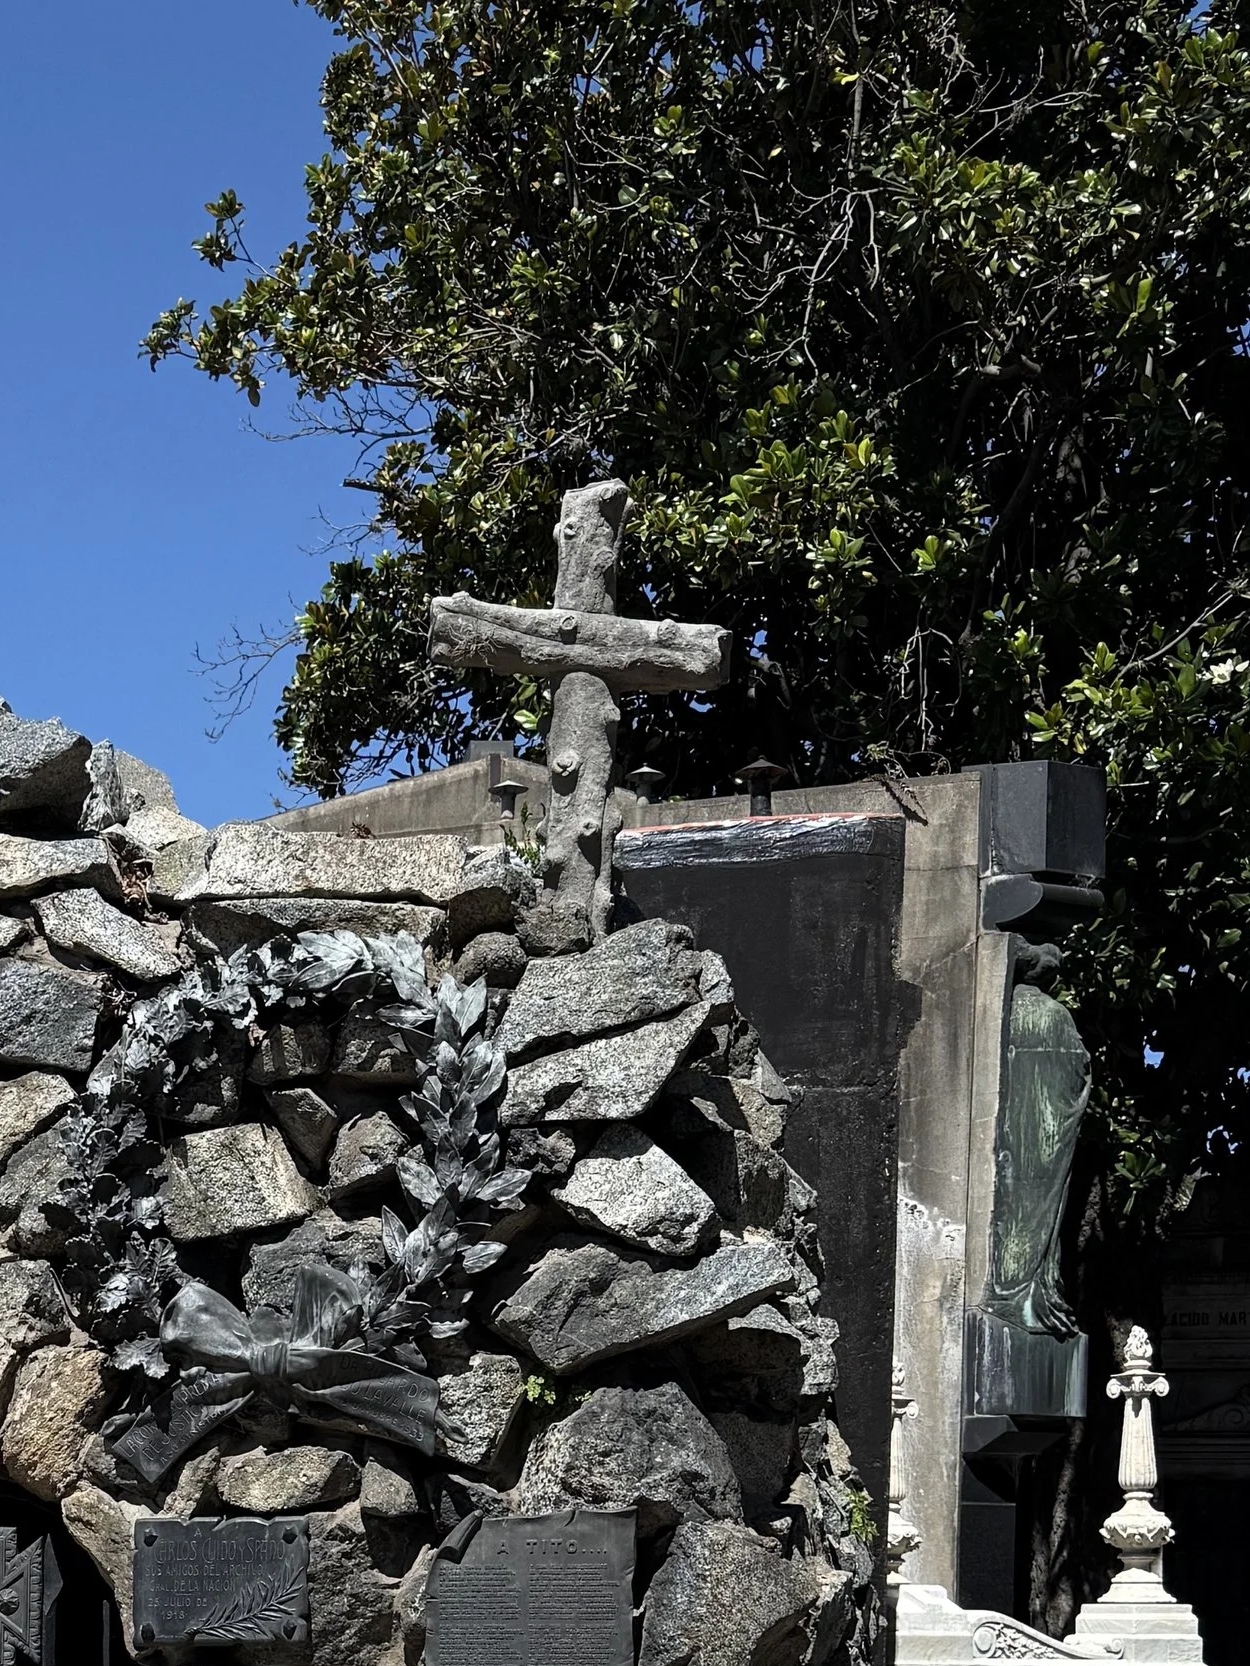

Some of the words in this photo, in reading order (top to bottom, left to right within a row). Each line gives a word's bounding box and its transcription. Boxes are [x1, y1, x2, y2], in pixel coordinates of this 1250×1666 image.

[1218, 1311, 1250, 1327] MAR
[363, 1382, 427, 1425] LAVALLE
[193, 1527, 203, 1538] A
[153, 1537, 198, 1564] CARLOS
[201, 1536, 237, 1564] GUIDO
[246, 1536, 286, 1563] SPANO
[497, 1539, 510, 1555] A
[145, 1564, 162, 1577] SUS
[166, 1564, 200, 1577] AMIGOS
[203, 1564, 221, 1576] DEL
[188, 1579, 200, 1592] LA
[163, 1597, 191, 1607] JULIO
[196, 1597, 208, 1607] DE
